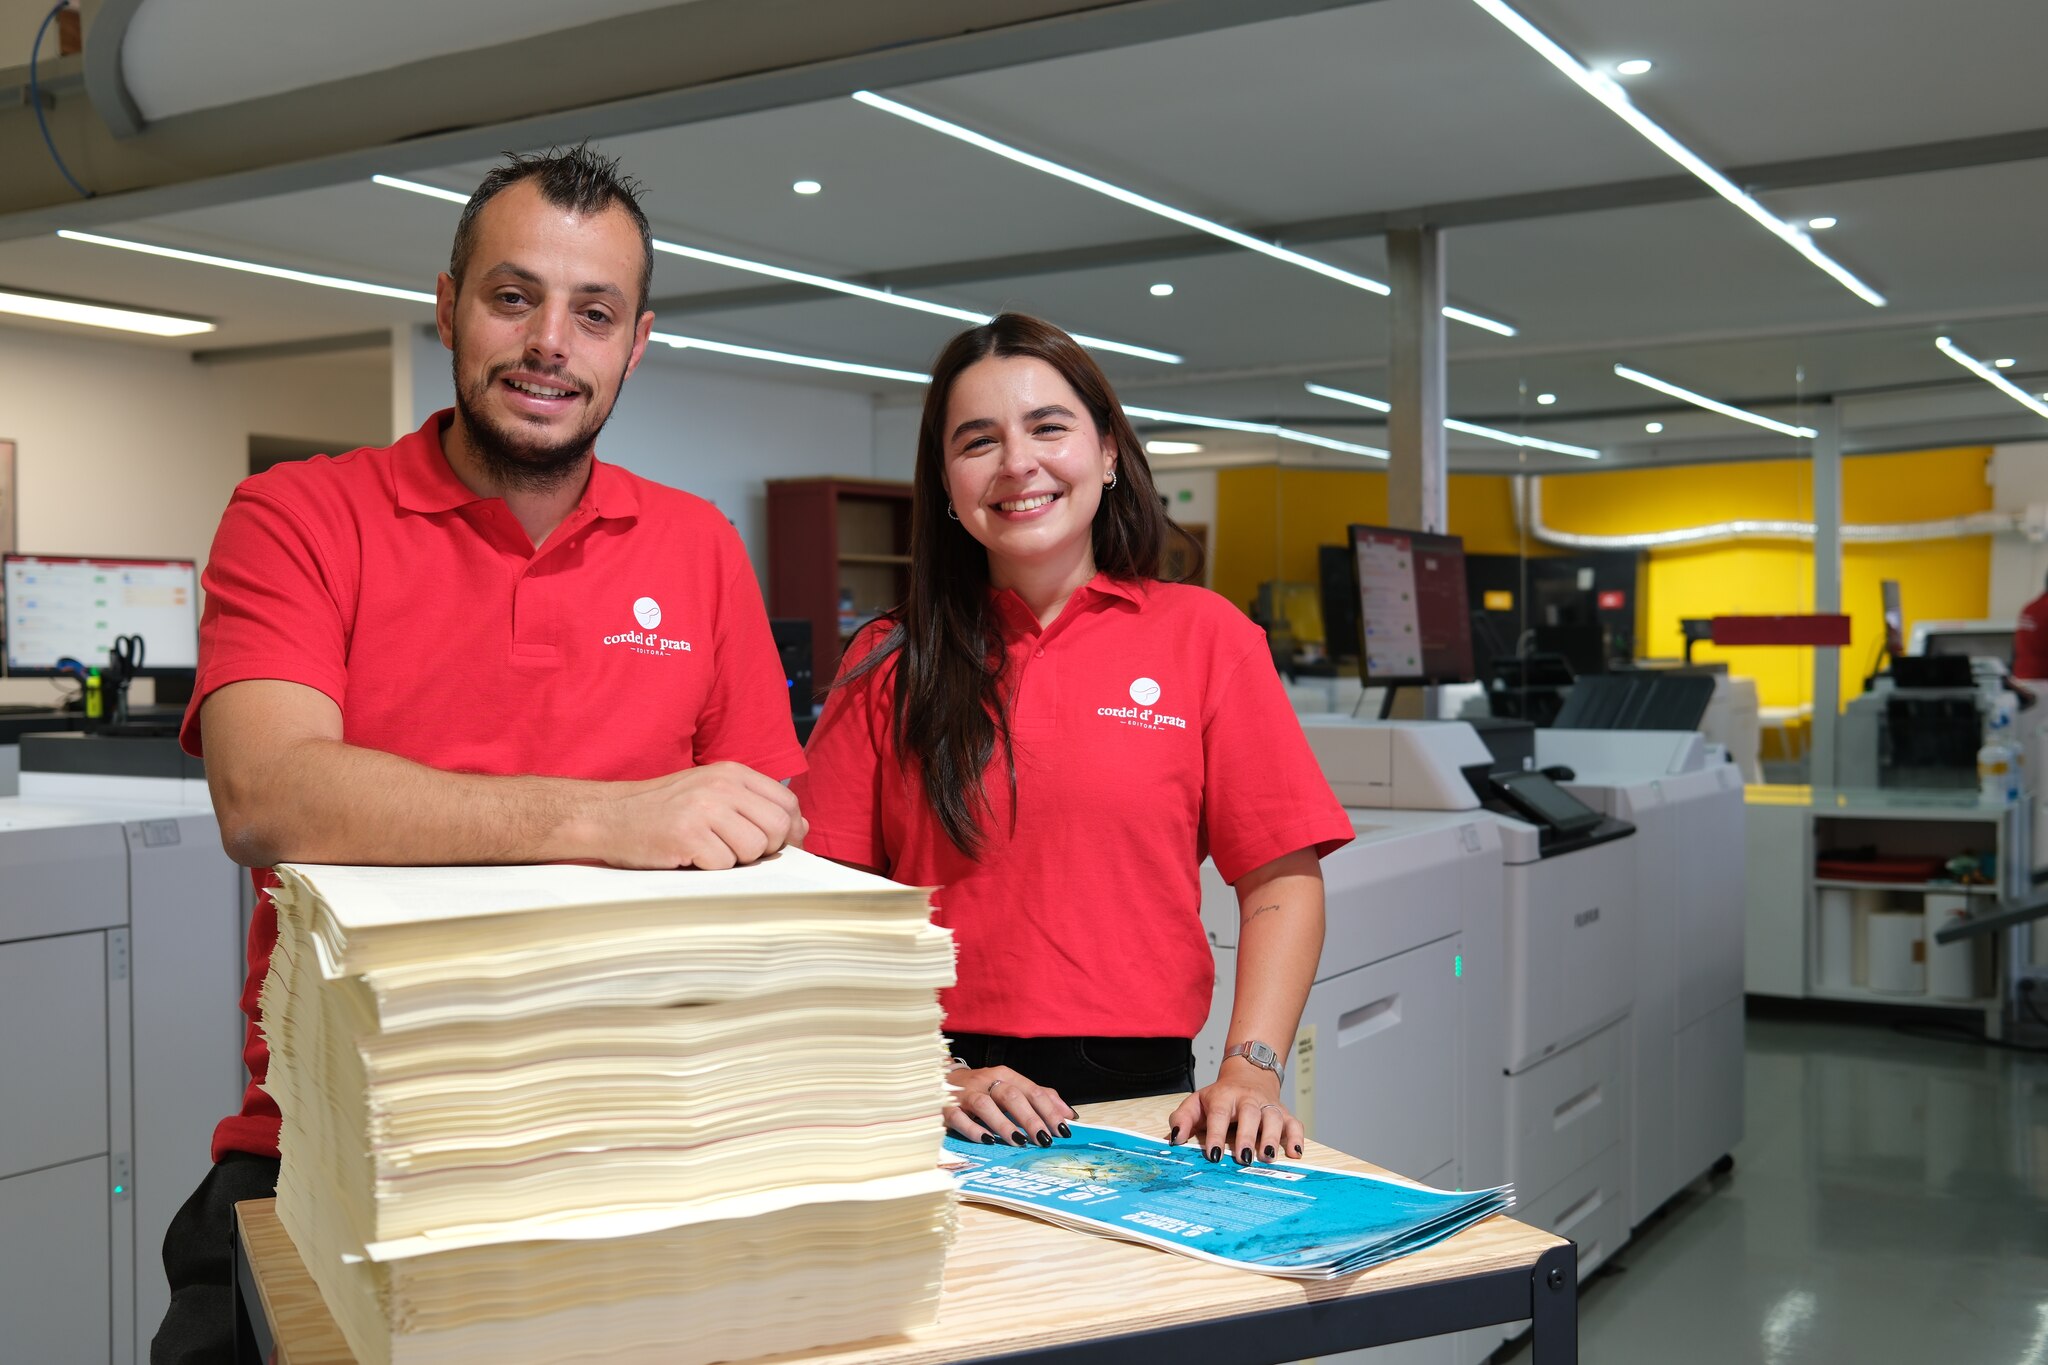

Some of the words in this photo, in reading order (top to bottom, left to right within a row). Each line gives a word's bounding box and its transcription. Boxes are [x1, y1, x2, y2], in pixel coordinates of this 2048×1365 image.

[603, 630, 643, 645] cordel
[660, 638, 691, 651] prata
[636, 647, 664, 656] EDITORA
[1097, 706, 1137, 718] cordel
[1153, 714, 1186, 728] prata
[1127, 720, 1157, 730] EDITORA
[955, 1171, 1065, 1196] TEMPO
